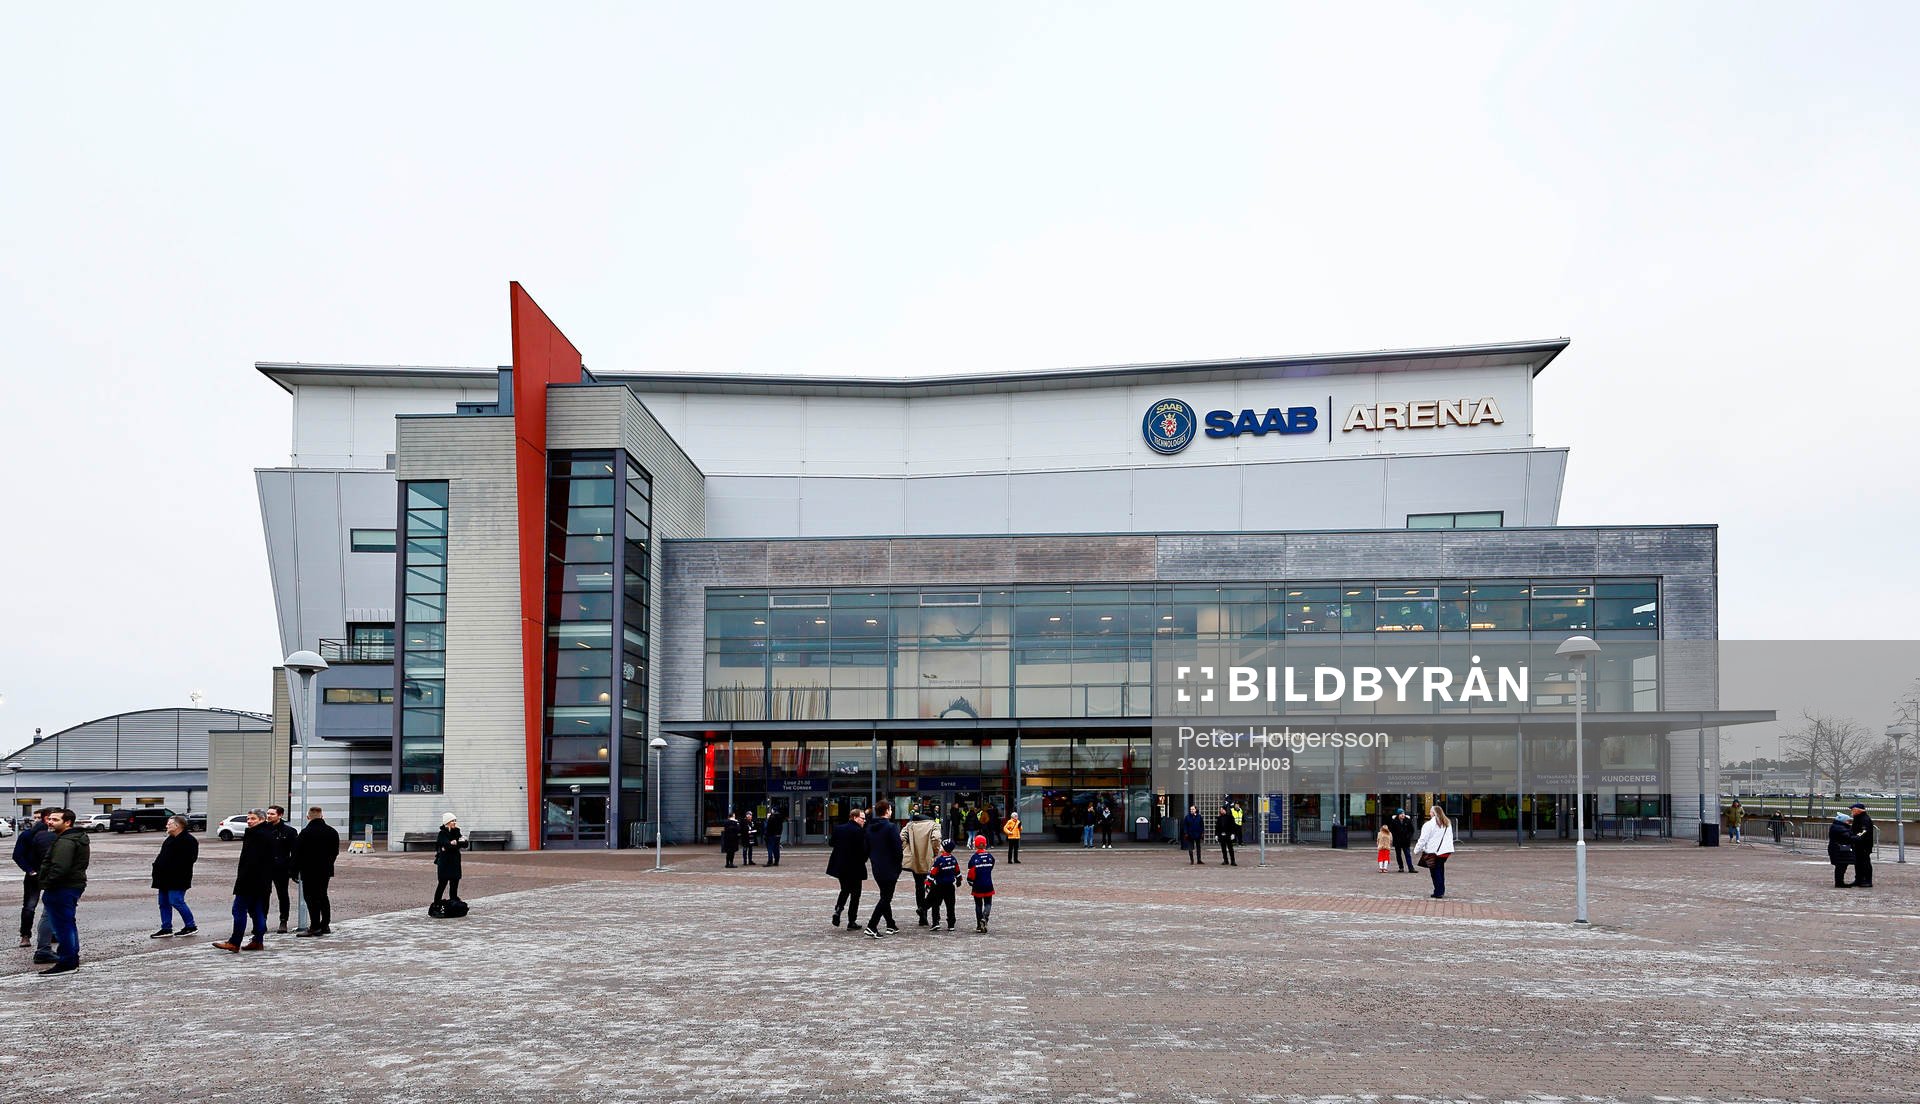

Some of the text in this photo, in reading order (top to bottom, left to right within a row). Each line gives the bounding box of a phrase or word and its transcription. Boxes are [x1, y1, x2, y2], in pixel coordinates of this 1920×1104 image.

[1156, 403, 1183, 413] SAAB
[1204, 397, 1504, 438] SAAB ARENA
[363, 784, 393, 793] STORA
